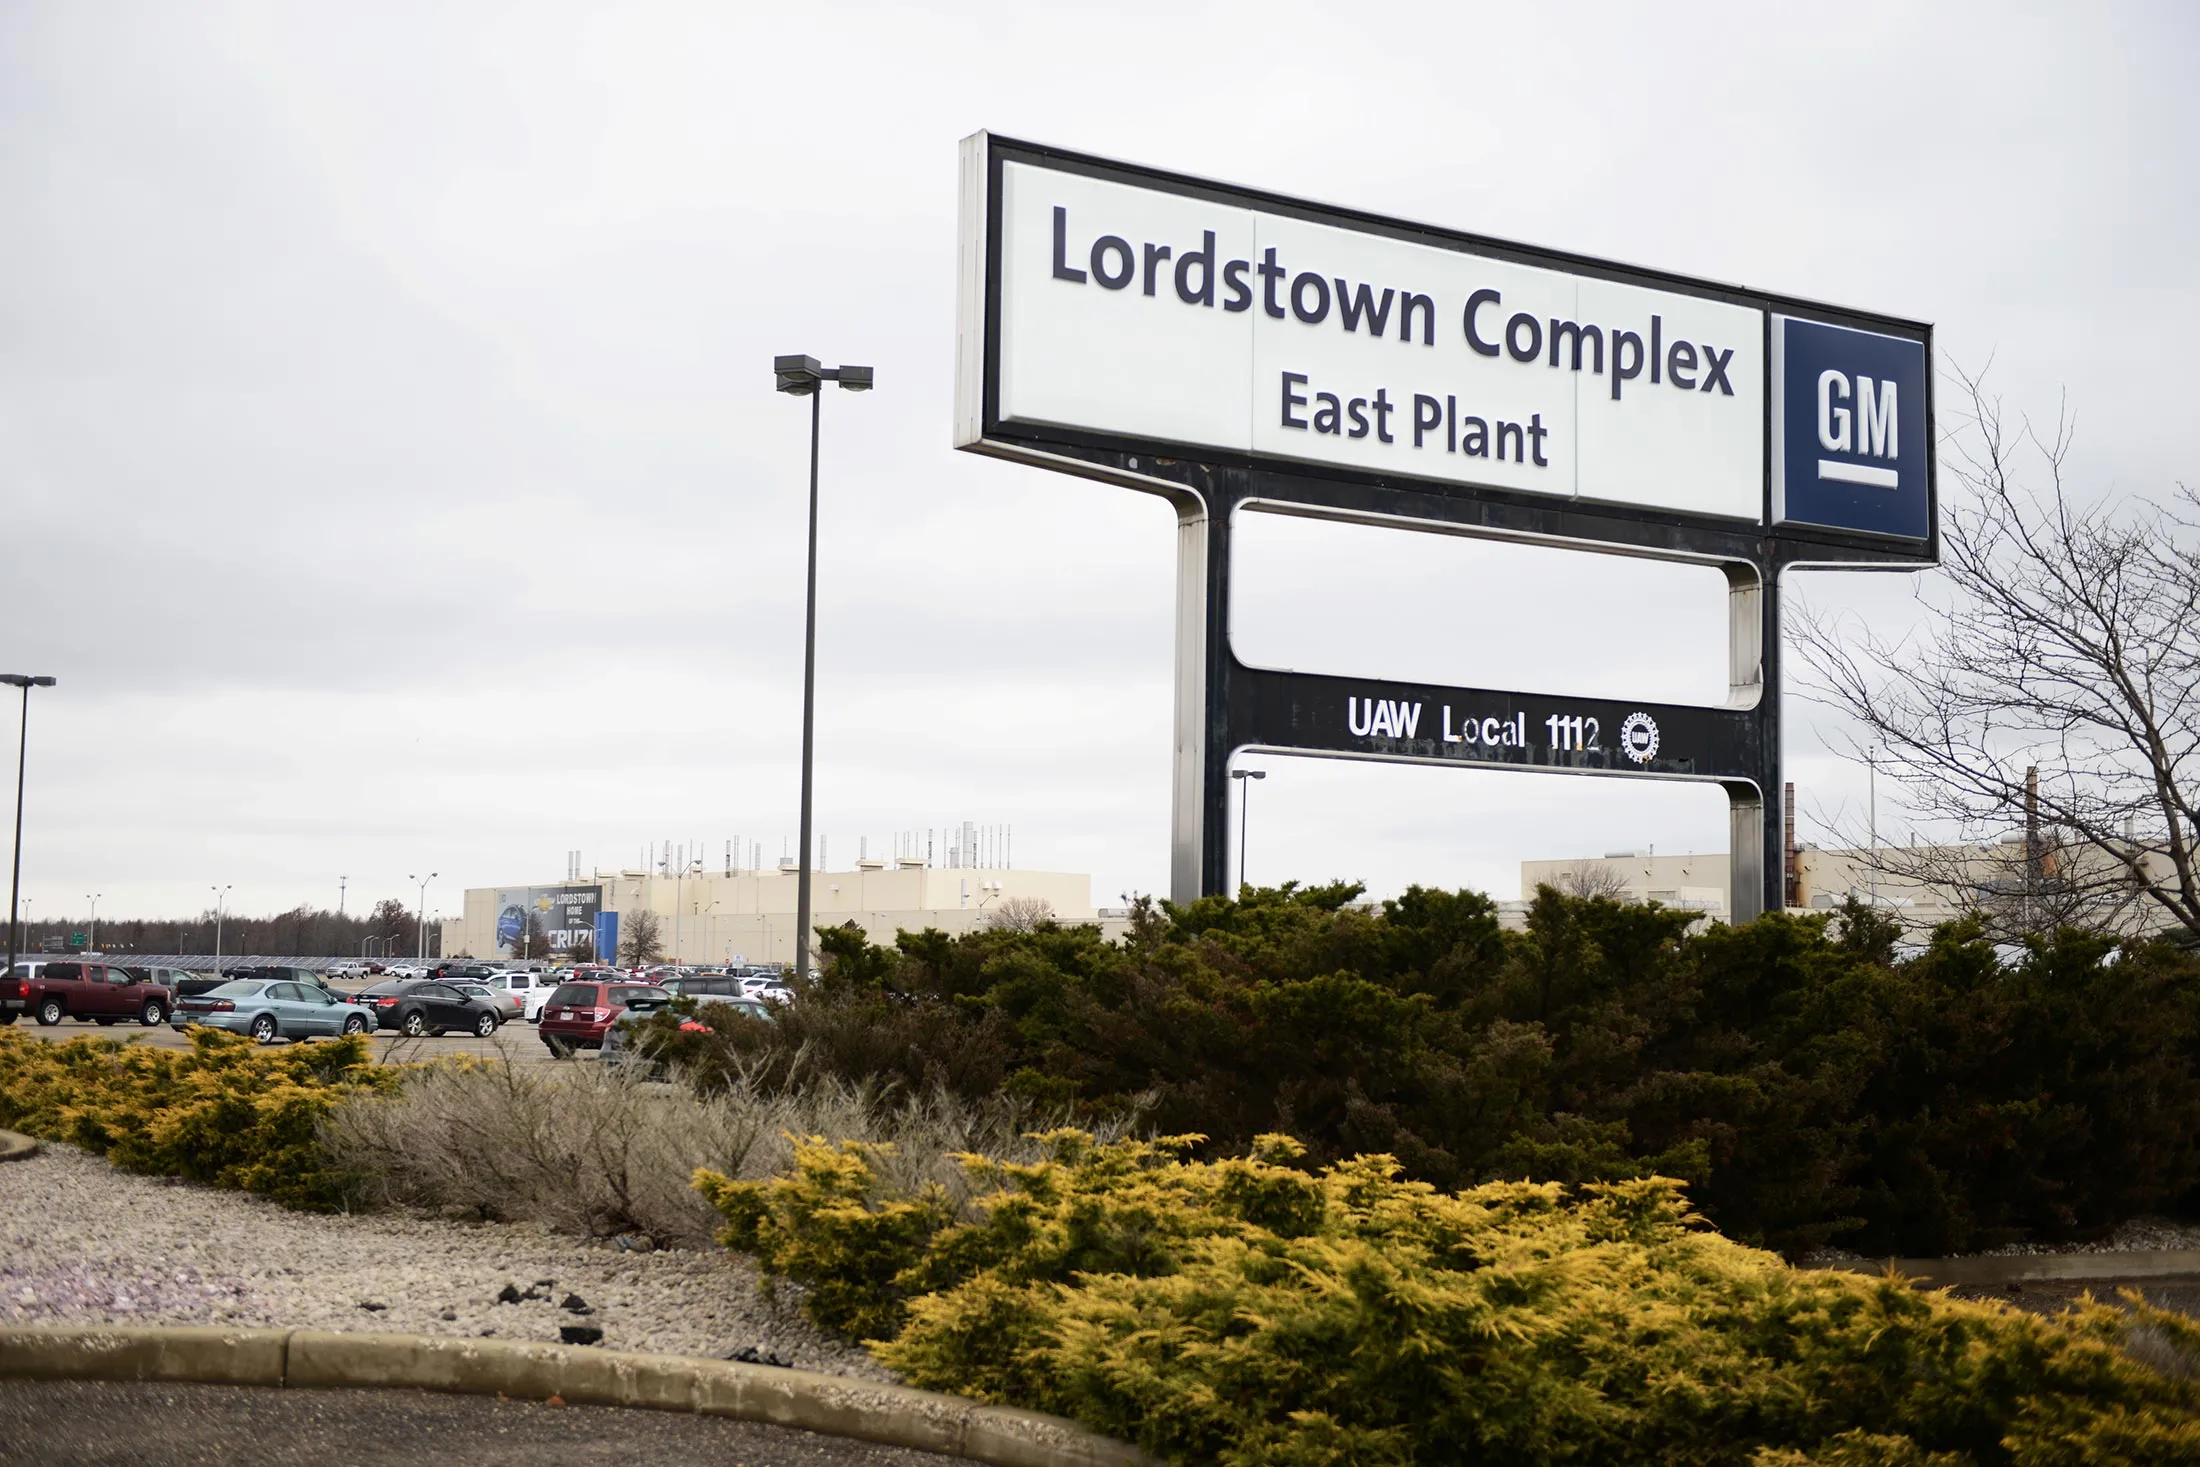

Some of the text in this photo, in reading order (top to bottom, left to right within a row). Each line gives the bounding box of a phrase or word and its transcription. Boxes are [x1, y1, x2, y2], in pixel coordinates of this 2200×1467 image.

[1052, 206, 1736, 401] Lordstown Complex
[1281, 372, 1549, 467] East Plant
[1816, 368, 1899, 460] GM
[1348, 696, 1601, 752] UAW Local 1112
[556, 892, 597, 905] LORDSTOWN
[566, 906, 583, 915] HOME
